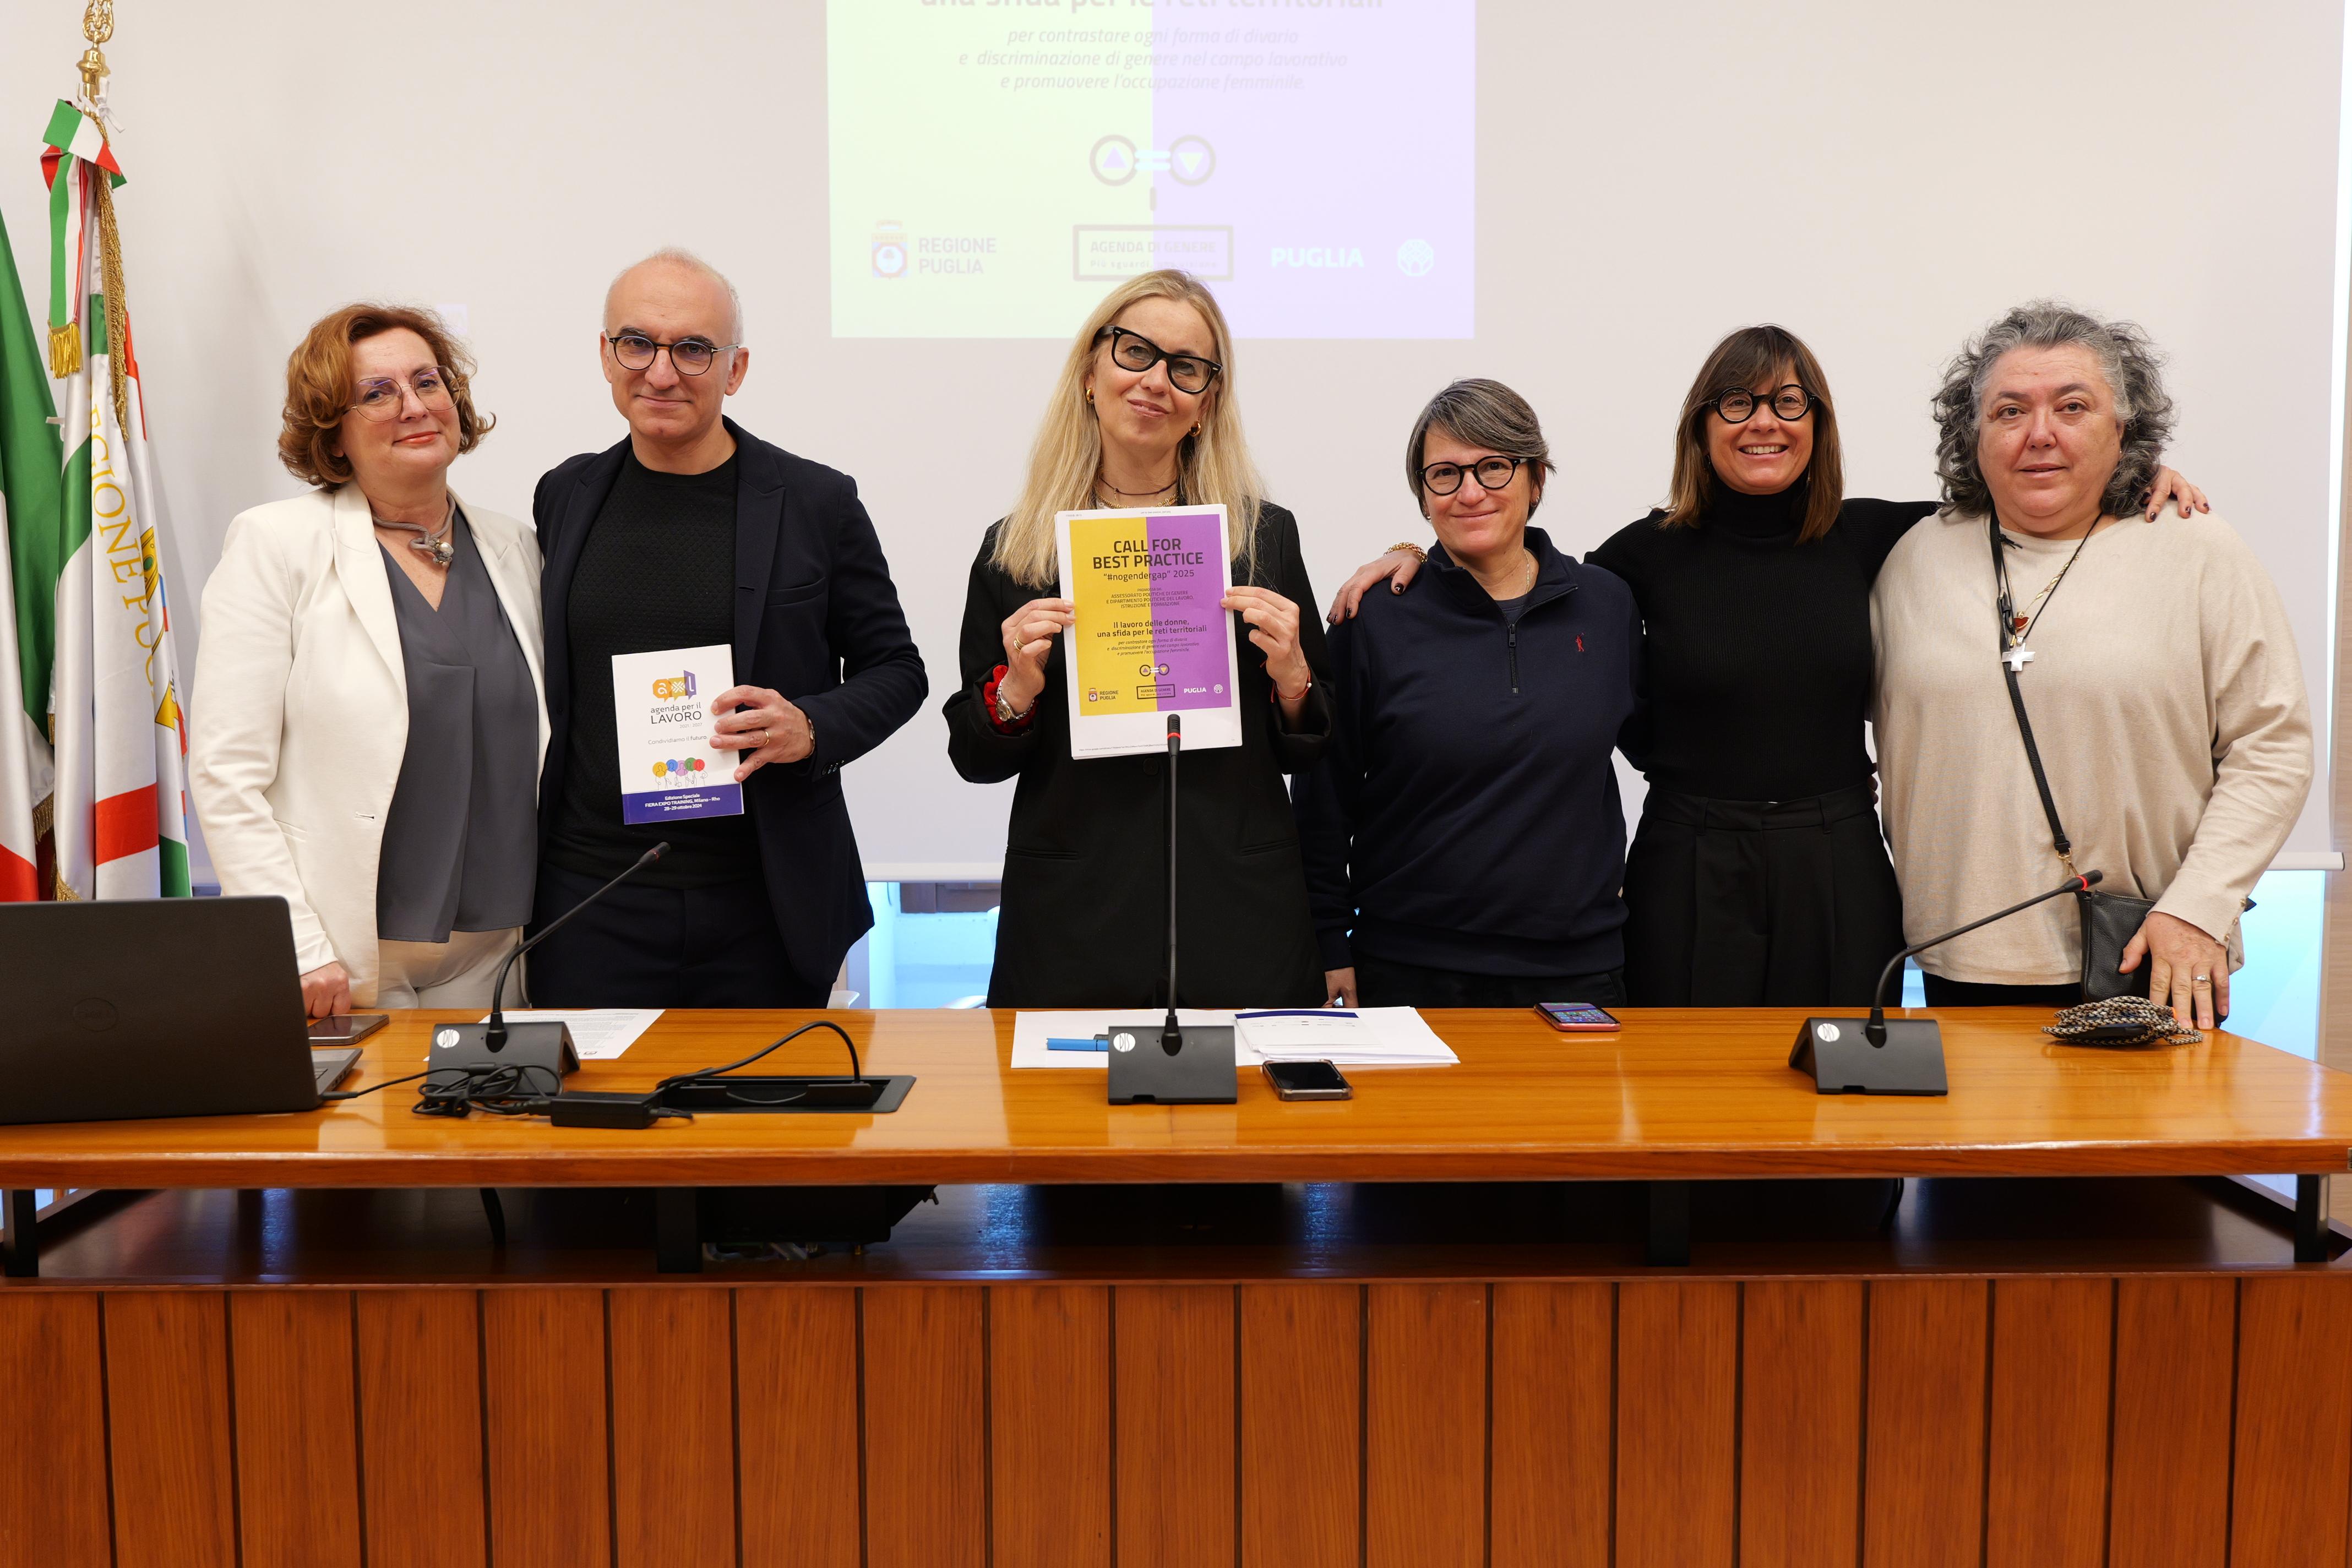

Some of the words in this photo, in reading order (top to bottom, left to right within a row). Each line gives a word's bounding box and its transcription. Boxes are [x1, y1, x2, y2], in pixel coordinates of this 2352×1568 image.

[1007, 30, 1034, 46] per
[1039, 29, 1130, 42] contrastare
[1134, 28, 1167, 47] ogni
[1172, 28, 1221, 46] forma
[1225, 28, 1240, 43] di
[1244, 28, 1299, 43] divario
[959, 53, 968, 65] e
[977, 50, 1101, 65] discriminazione
[1106, 51, 1120, 65] di
[1124, 53, 1182, 69] genere
[1183, 51, 1207, 66] nel
[1211, 54, 1263, 70] campo
[1268, 51, 1348, 67] lavorativo
[1001, 77, 1009, 88] e
[1014, 76, 1109, 92] promuovere
[1114, 73, 1221, 92] l'occupazione
[918, 237, 997, 253] REGIONE
[1091, 241, 1143, 253] AGENDA
[1148, 241, 1160, 253] DI
[1164, 241, 1216, 253] GENERE
[1271, 247, 1364, 268] PUGLIA
[918, 258, 983, 274] PUGLIA
[1114, 540, 1148, 553] CALL
[1152, 538, 1181, 551] FOR
[1093, 556, 1129, 569] BEST
[1134, 552, 1204, 567] PRACTICE
[1174, 569, 1194, 578] 2025
[651, 705, 679, 715] agenda
[682, 704, 694, 712] per
[651, 711, 701, 724] LAVORO
